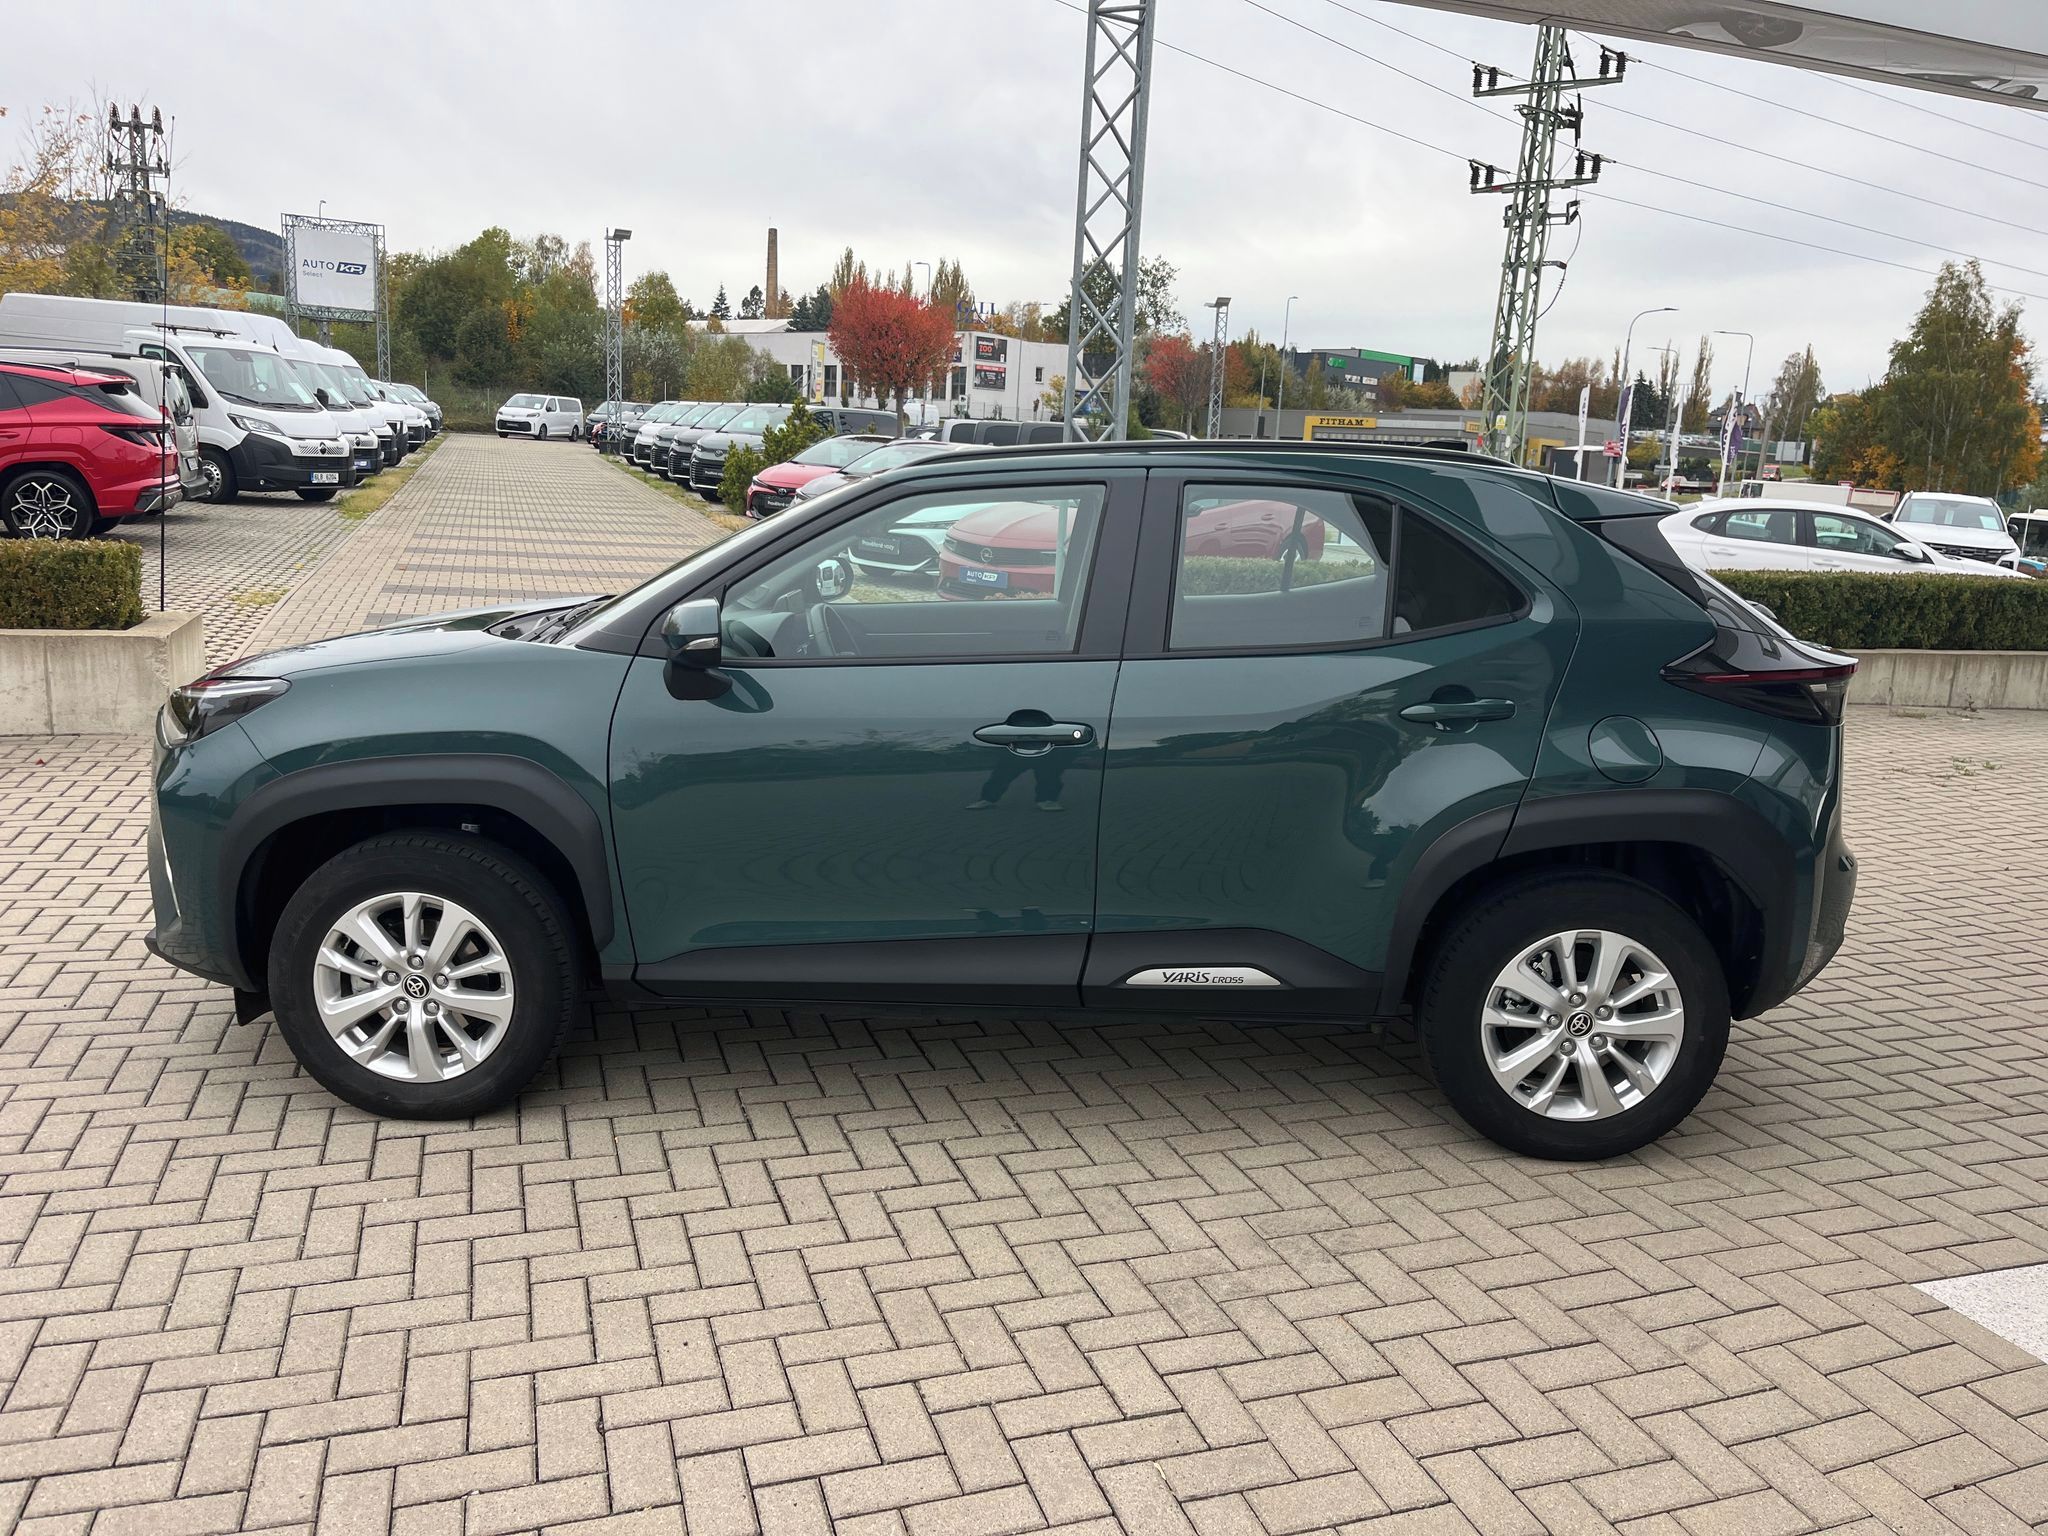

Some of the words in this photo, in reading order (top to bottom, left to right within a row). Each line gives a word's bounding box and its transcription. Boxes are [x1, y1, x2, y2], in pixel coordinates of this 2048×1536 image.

[302, 259, 335, 270] AUTO
[302, 270, 323, 278] Select
[1319, 417, 1364, 426] FITHAM
[966, 570, 982, 578] AUTO
[1212, 976, 1244, 984] CROSS
